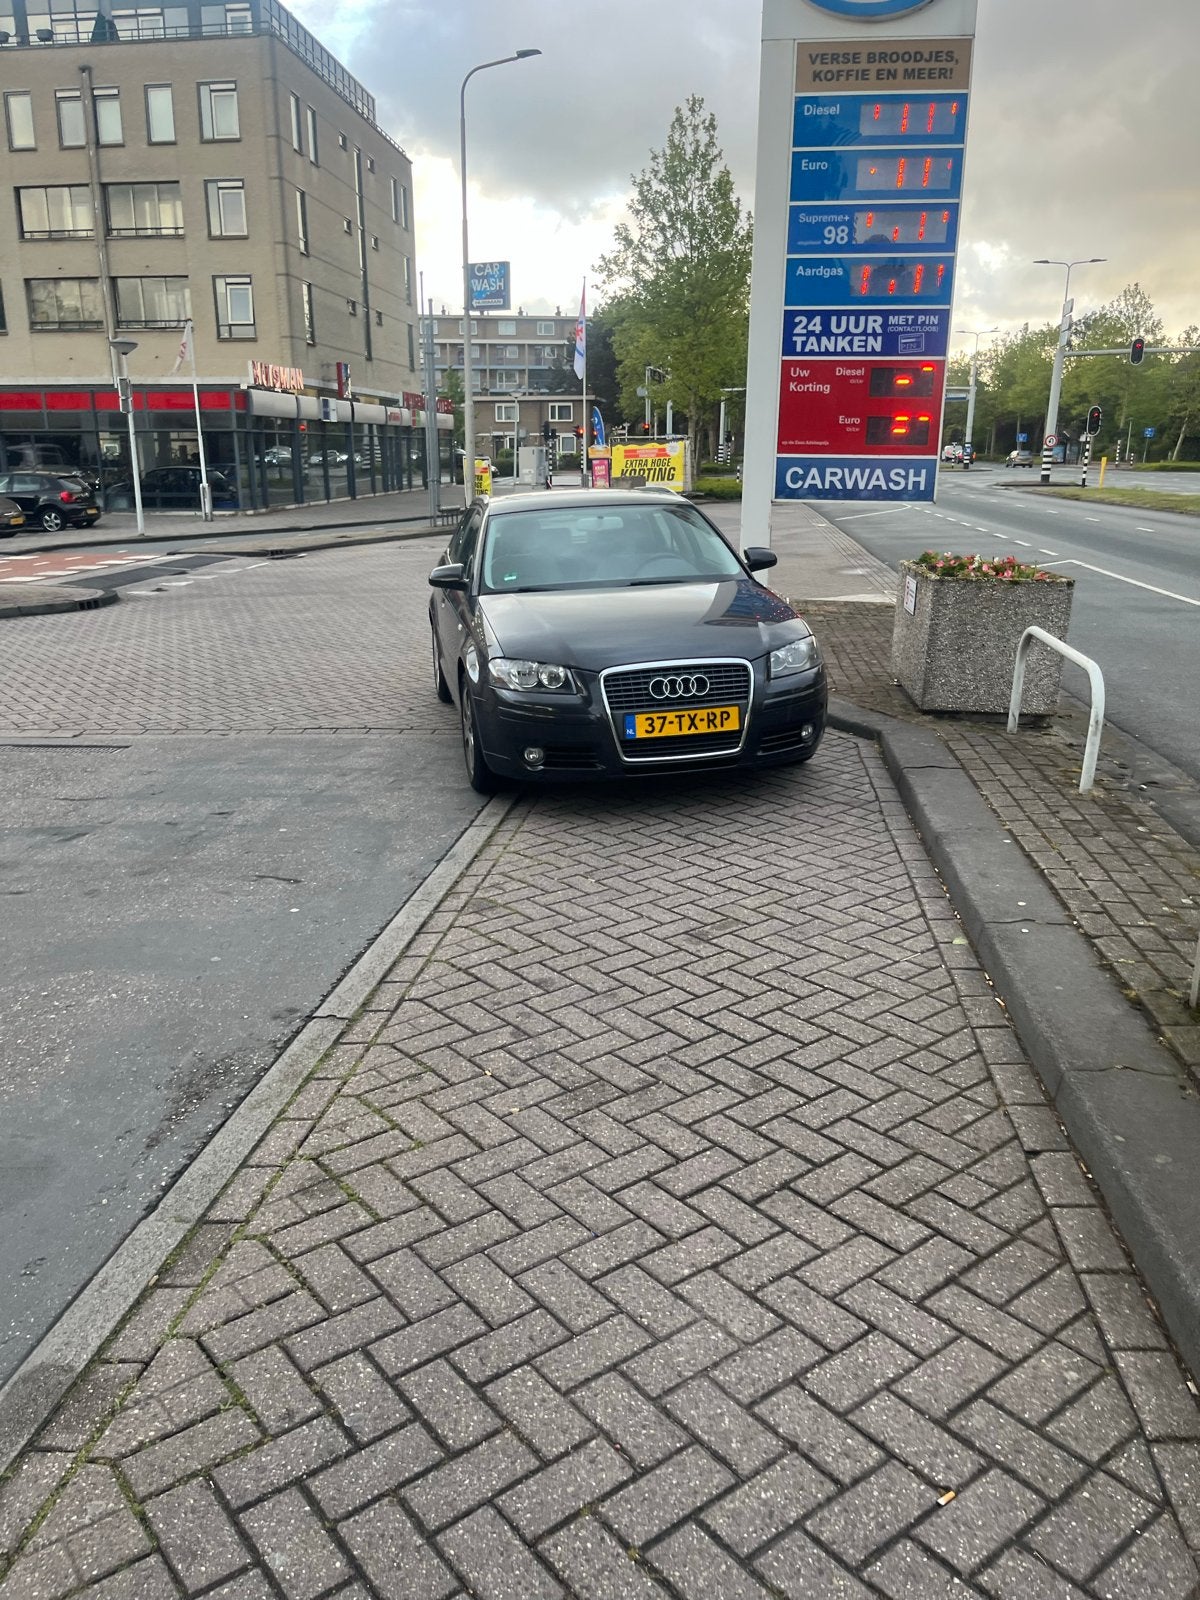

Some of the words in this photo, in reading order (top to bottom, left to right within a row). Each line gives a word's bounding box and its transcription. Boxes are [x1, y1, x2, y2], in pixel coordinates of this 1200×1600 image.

[809, 52, 862, 65] VERSE
[866, 50, 959, 65] BROODJES,
[812, 69, 870, 82] KOFFIE
[875, 68, 898, 80] EN
[903, 67, 954, 80] MEER!
[803, 104, 840, 116] Diesel
[801, 159, 828, 171] Euro
[799, 213, 850, 224] Supreme+
[823, 226, 849, 245] 98
[474, 263, 500, 276] CAR
[796, 266, 844, 279] Aardgas
[471, 278, 504, 292] WASH
[793, 316, 822, 334] 24
[830, 315, 883, 334] UUR
[888, 316, 915, 325] MET
[918, 315, 939, 325] PIN
[792, 336, 882, 352] TANKEN
[790, 367, 810, 377] Uw
[835, 367, 865, 376] Diesel
[789, 382, 831, 394] Korting
[838, 415, 861, 425] Euro
[624, 459, 648, 469] EXTRA
[650, 458, 671, 467] HOGE
[785, 466, 927, 491] CARWASH
[644, 711, 731, 734] 37-TX-RP
